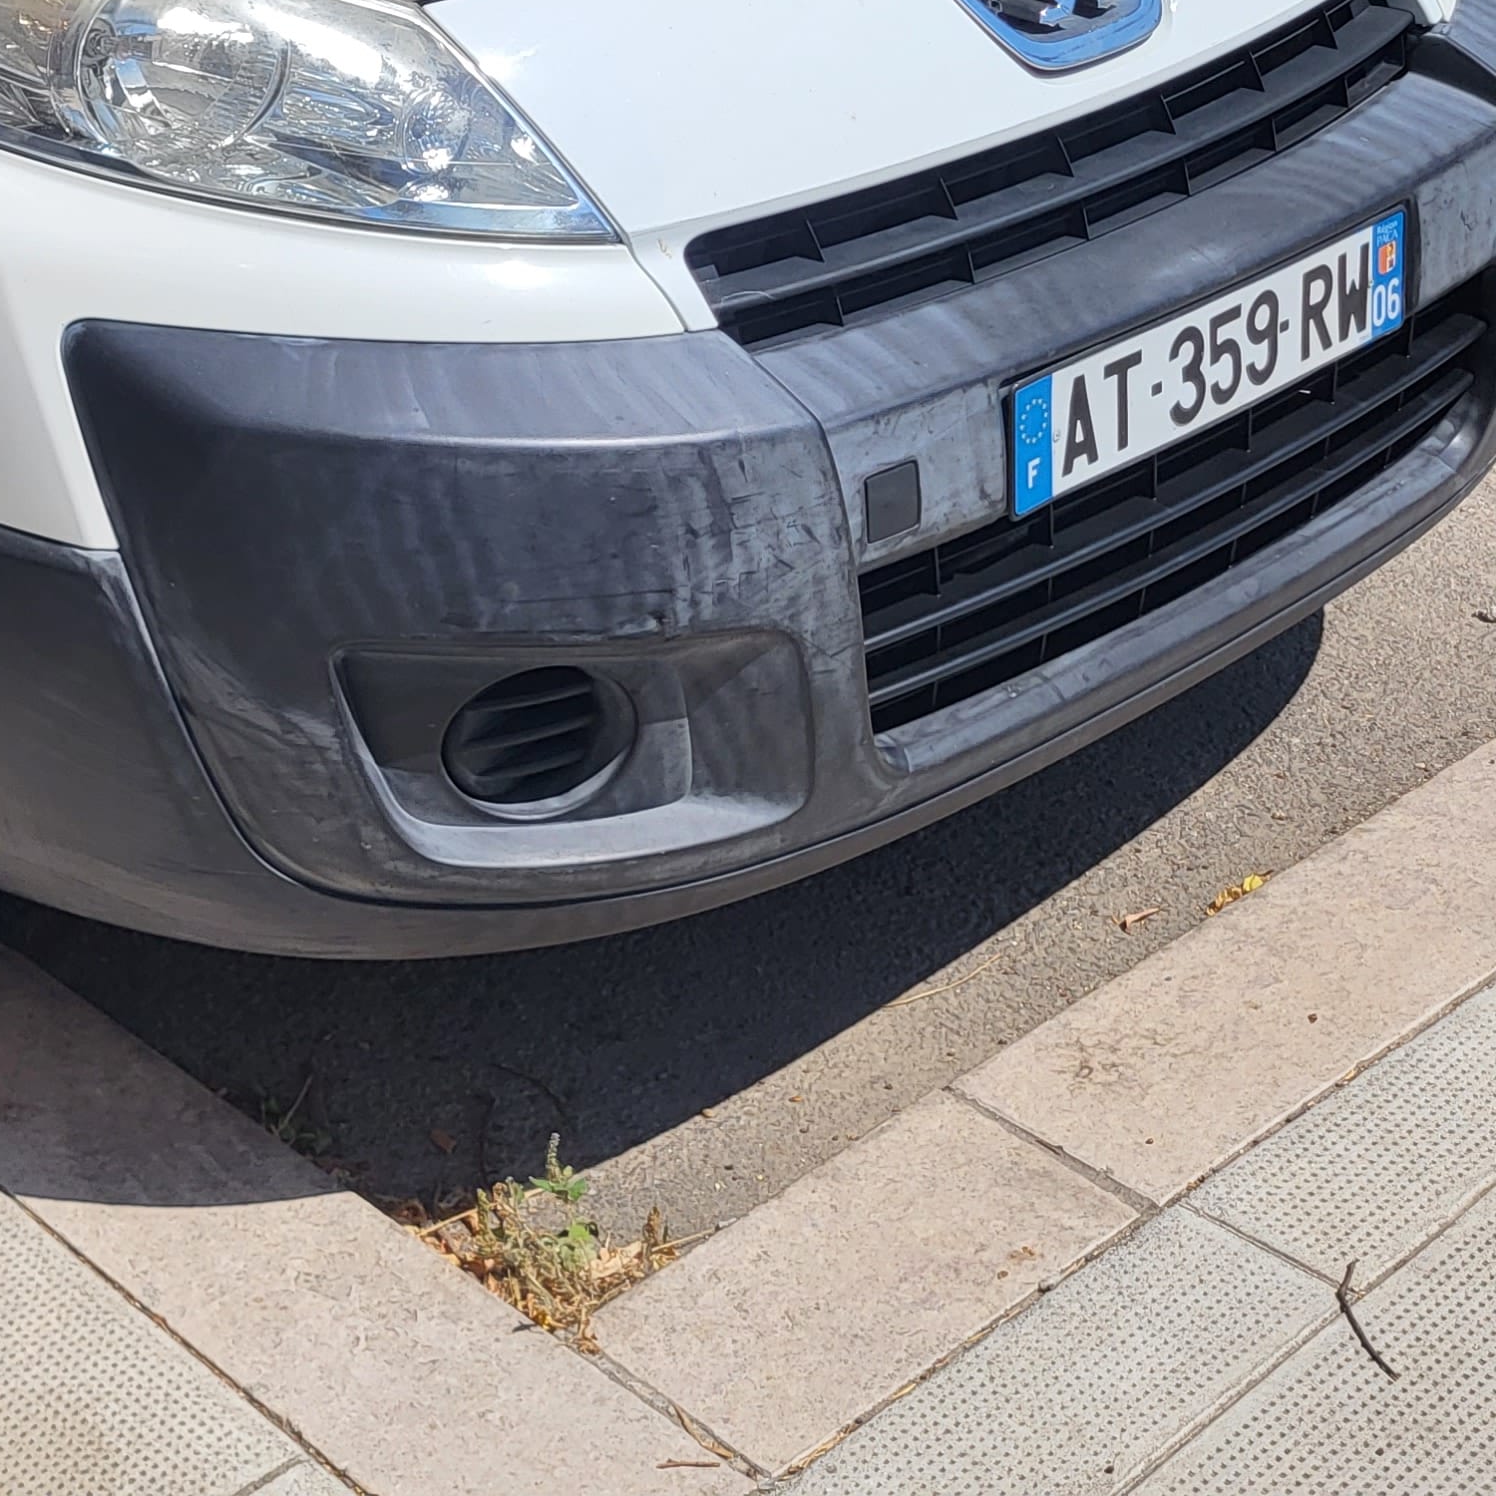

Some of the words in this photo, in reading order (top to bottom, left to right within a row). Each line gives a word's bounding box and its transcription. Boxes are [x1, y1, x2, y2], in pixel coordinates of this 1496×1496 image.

[1376, 229, 1398, 247] PACA
[1372, 277, 1401, 327] 06
[1061, 242, 1370, 478] AT-359-RW
[1027, 458, 1040, 490] F
